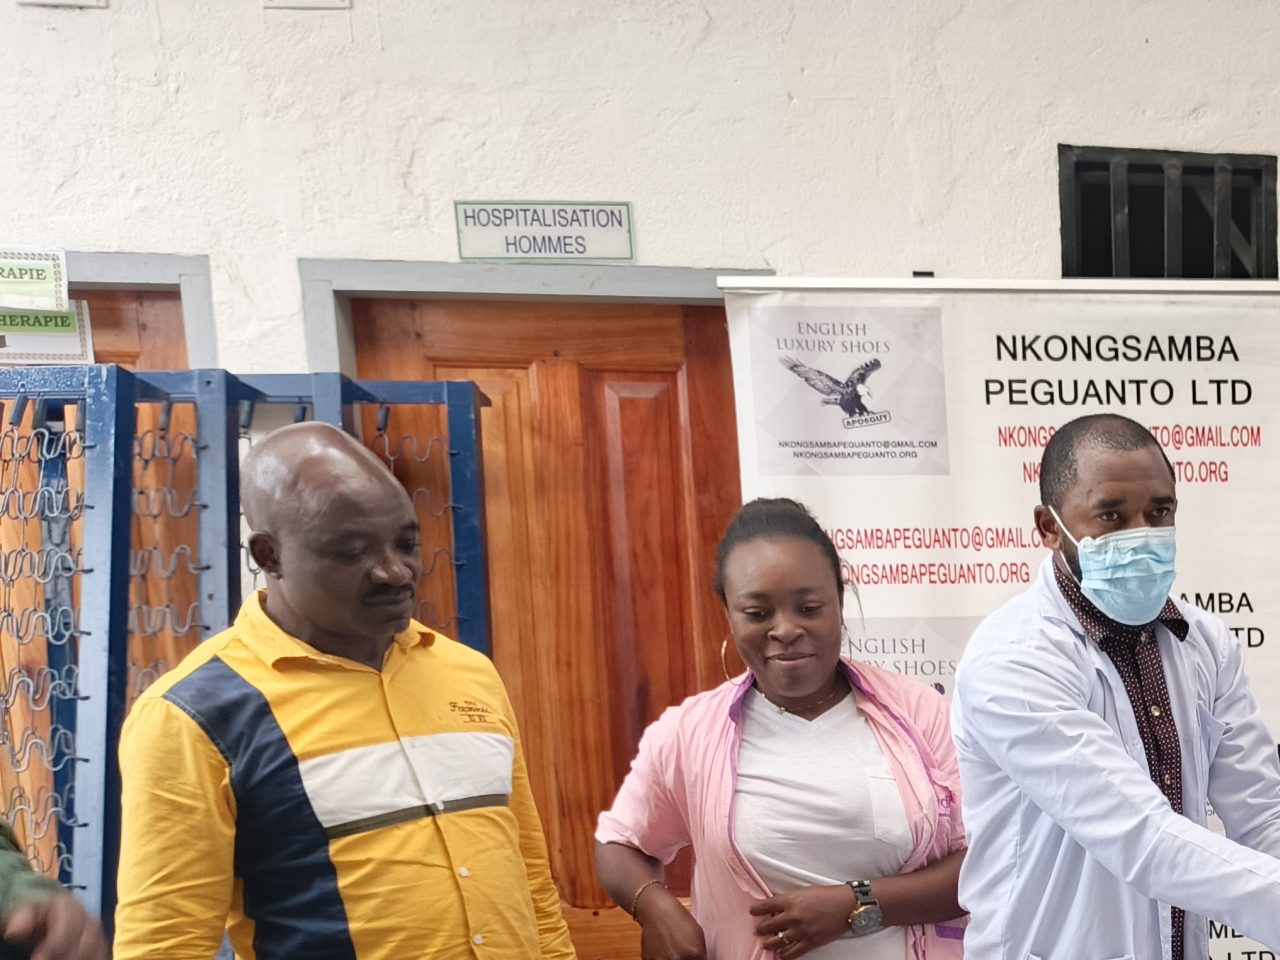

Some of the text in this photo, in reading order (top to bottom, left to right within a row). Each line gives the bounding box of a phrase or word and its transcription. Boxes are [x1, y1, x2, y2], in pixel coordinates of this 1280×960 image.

[464, 208, 623, 228] HOSPITALISATION
[505, 235, 587, 254] HOMMES
[797, 322, 867, 337] ENGLISH
[776, 338, 891, 354] LUXURY SHOES
[996, 334, 1239, 362] NKONGSAMBA
[984, 379, 1252, 406] PEGUANTO LTD
